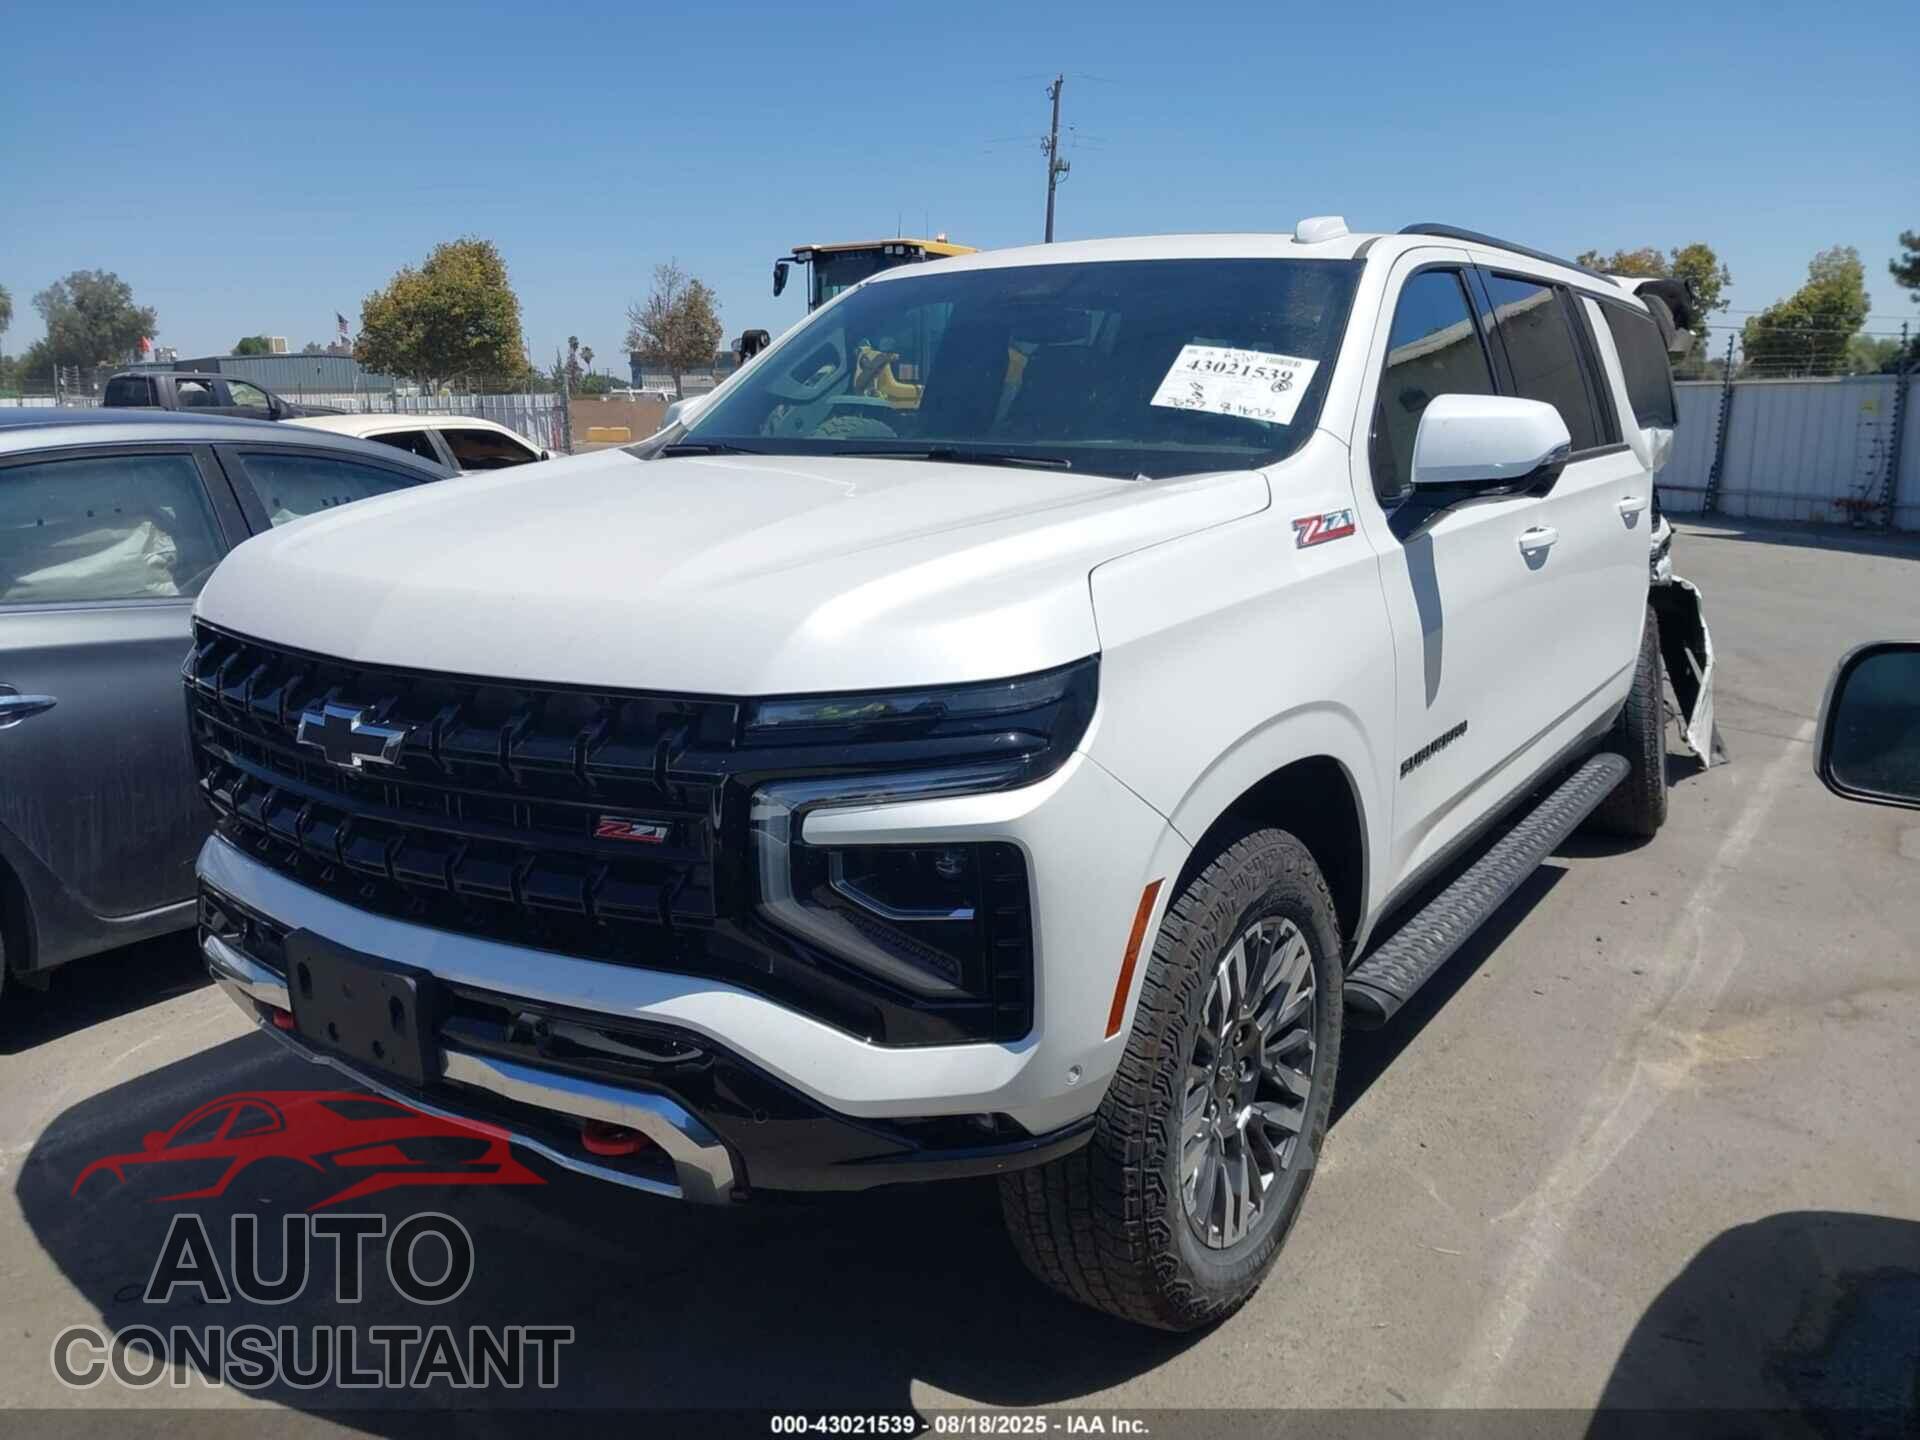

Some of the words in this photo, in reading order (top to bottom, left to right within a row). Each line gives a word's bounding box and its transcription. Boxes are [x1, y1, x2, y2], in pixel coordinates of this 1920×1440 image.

[1186, 359, 1294, 382] 43021539
[1292, 510, 1355, 549] Z71
[594, 815, 672, 842] Z71
